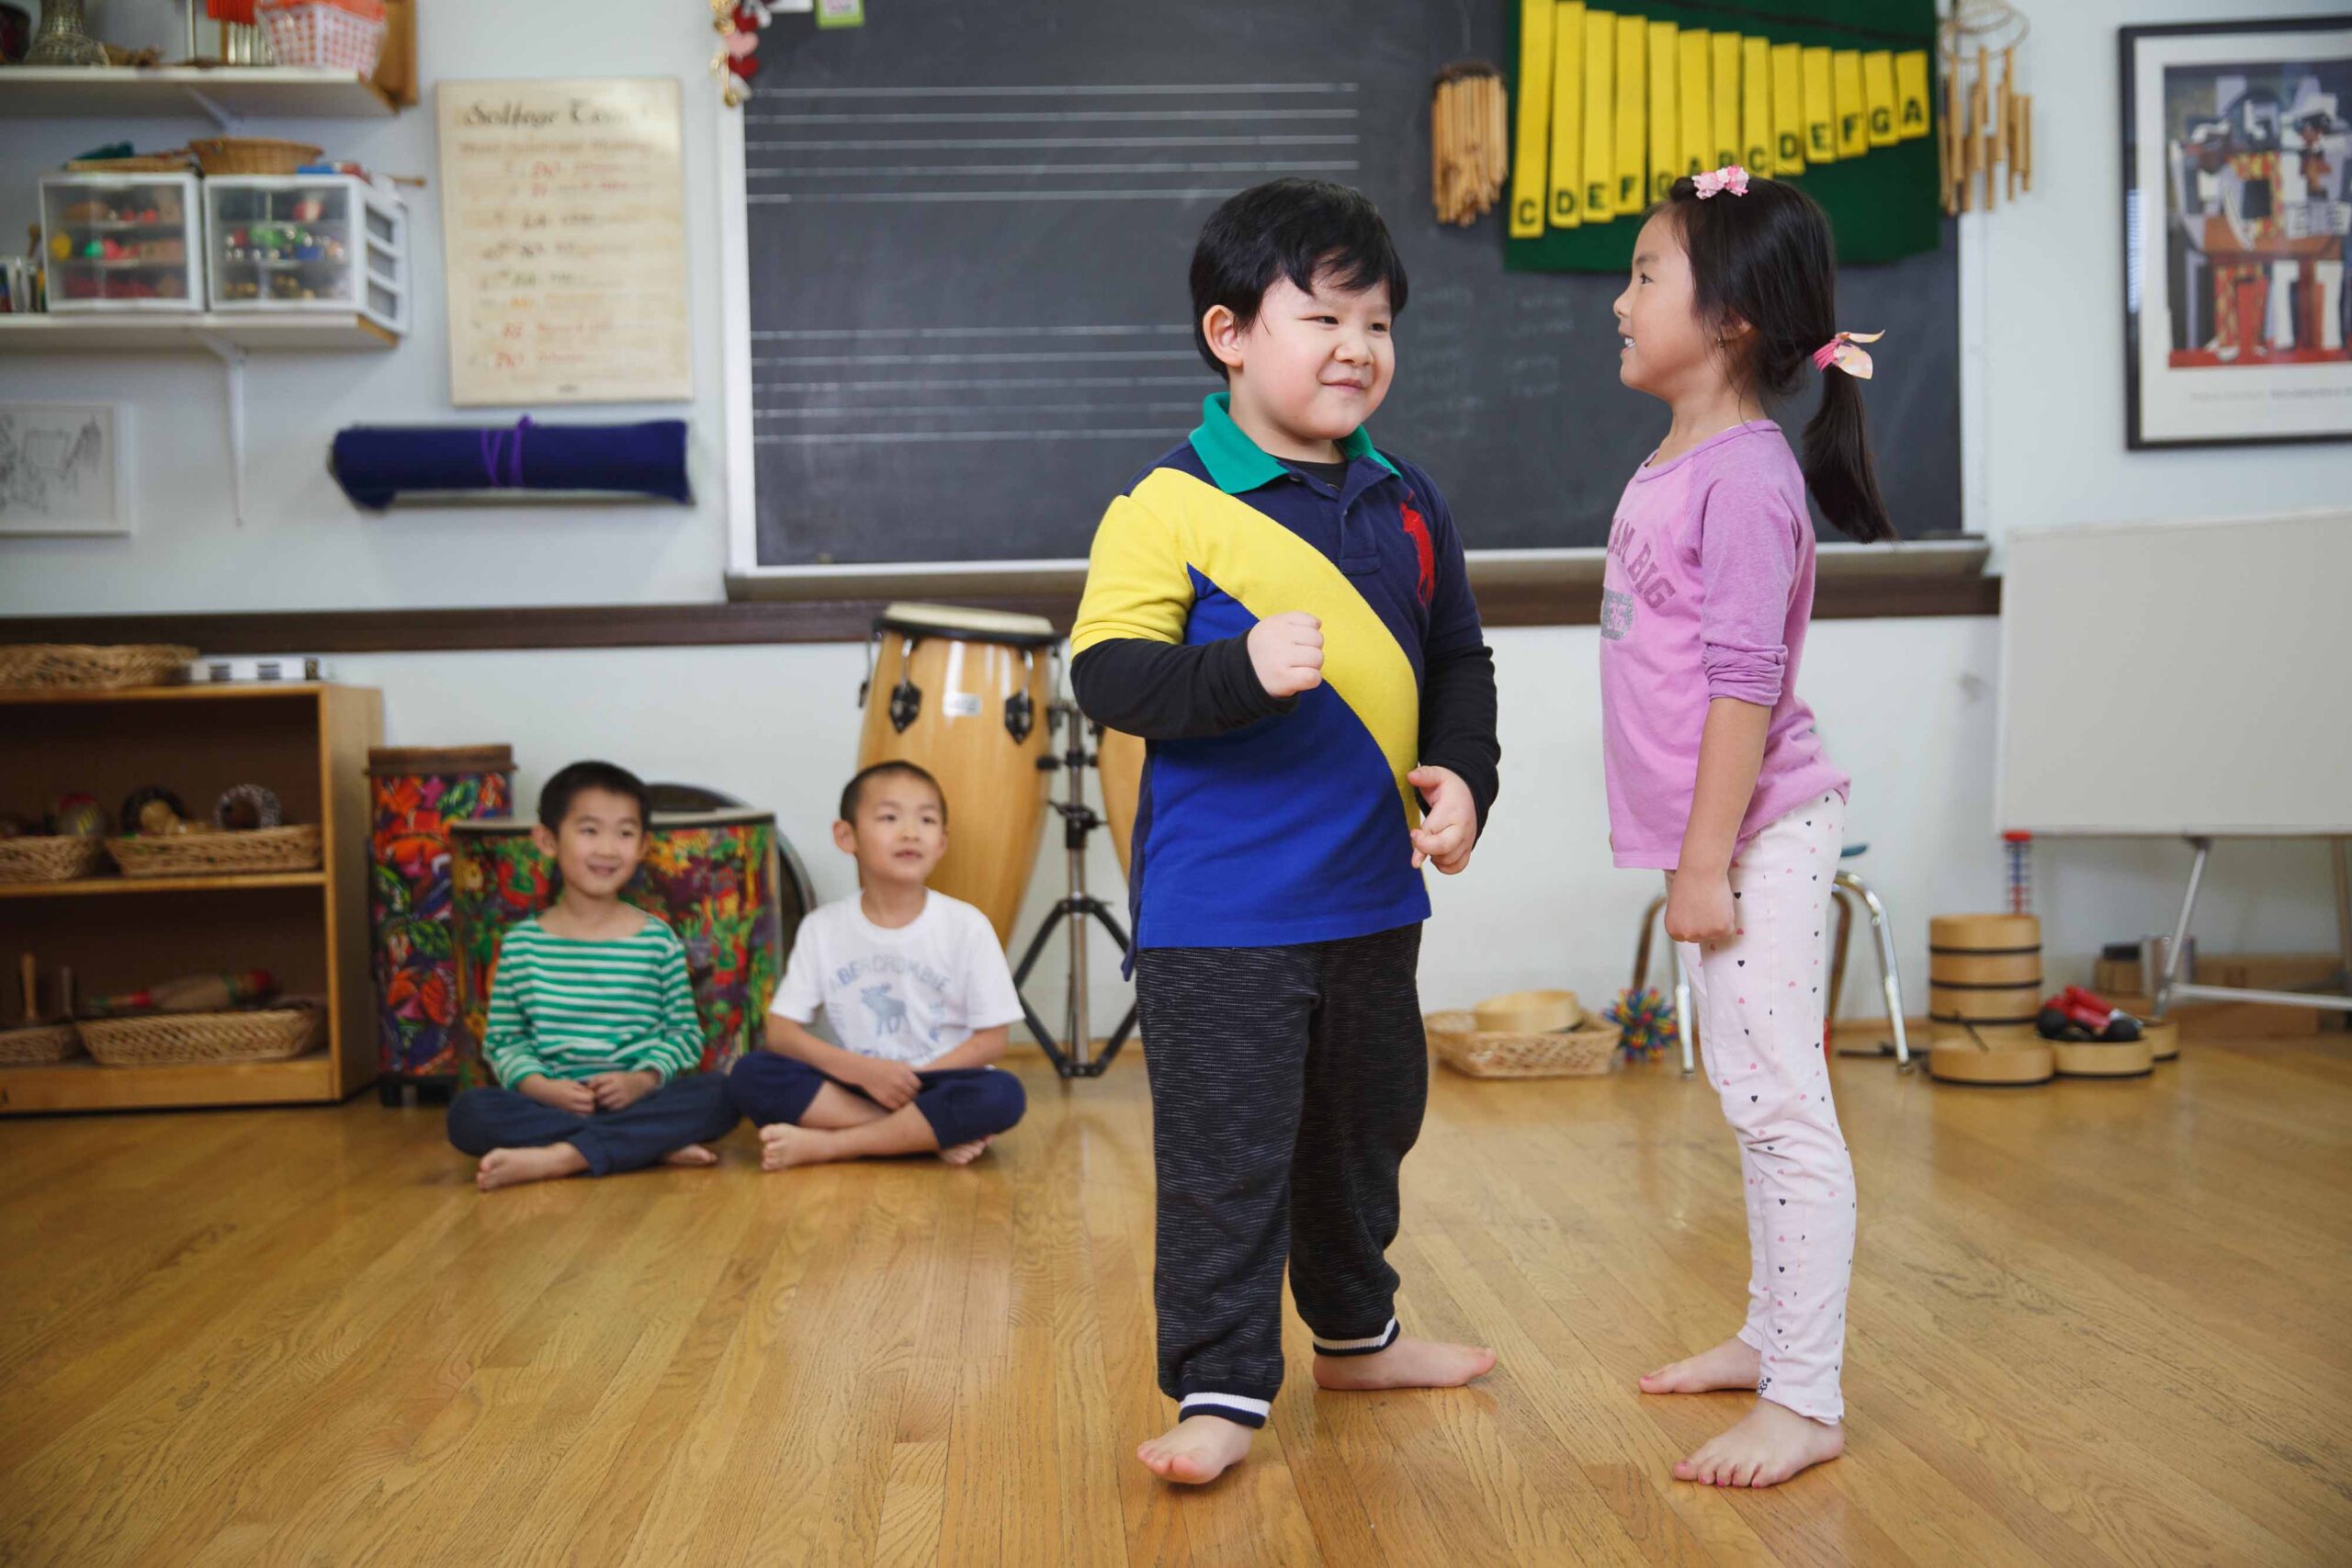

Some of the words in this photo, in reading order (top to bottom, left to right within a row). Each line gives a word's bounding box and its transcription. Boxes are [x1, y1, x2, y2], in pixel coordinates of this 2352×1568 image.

[1518, 198, 1537, 226] C
[1555, 189, 1575, 216] D
[1587, 182, 1608, 210] E
[1621, 175, 1636, 203] F
[1747, 146, 1767, 173] C
[1779, 133, 1797, 160] D
[1810, 122, 1829, 151] E
[1842, 112, 1860, 142] F
[1871, 106, 1891, 134] G
[1903, 96, 1923, 124] A
[1627, 541, 1677, 610] BIG
